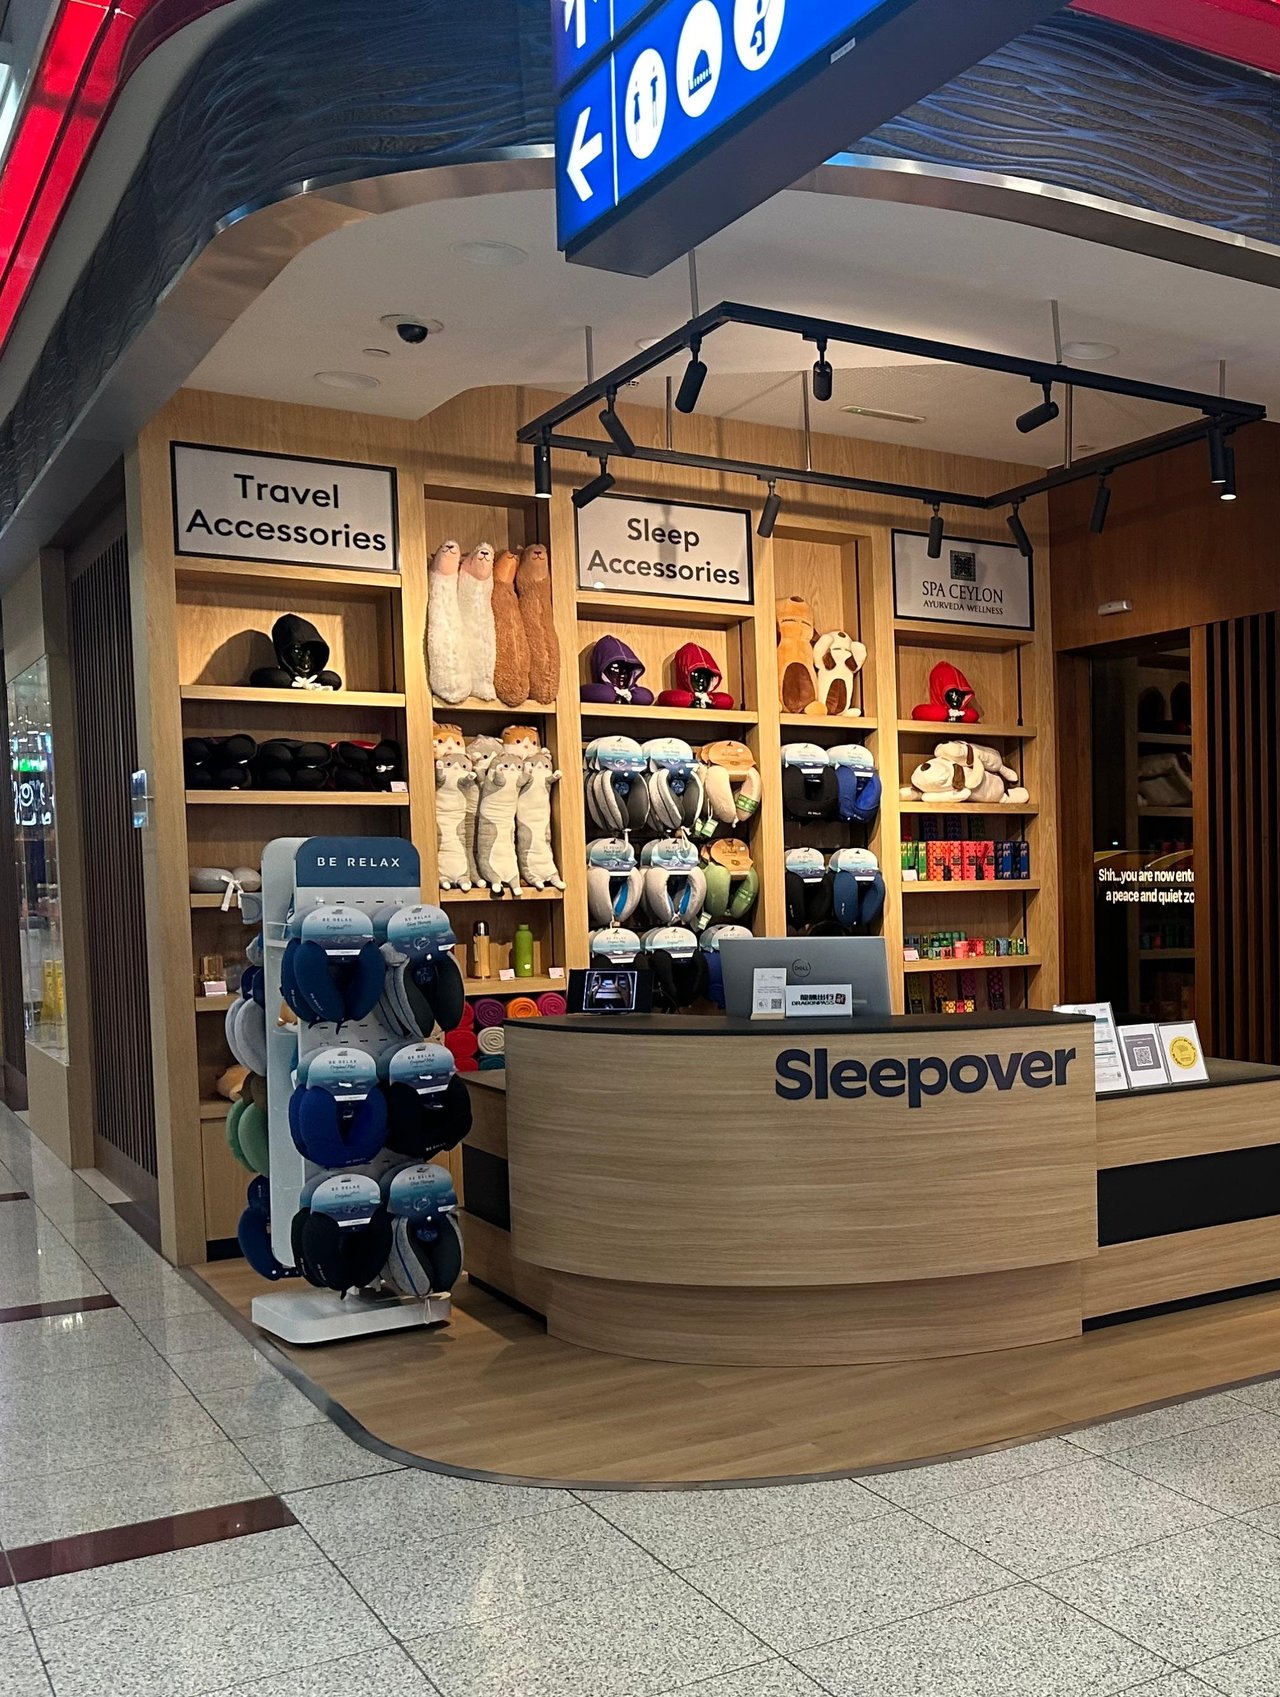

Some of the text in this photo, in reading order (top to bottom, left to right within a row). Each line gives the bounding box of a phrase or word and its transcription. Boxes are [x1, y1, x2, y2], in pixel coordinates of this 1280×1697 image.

[233, 473, 339, 509] Travel
[185, 508, 387, 551] Accessories
[627, 517, 700, 552] Sleep
[587, 549, 740, 585] Accessories
[922, 580, 1003, 604] SPA CEYLON
[923, 600, 1004, 615] AYURVEDA WELLNESS
[317, 857, 400, 867] BE RELAX
[1138, 871, 1153, 882] are
[1154, 871, 1175, 882] now
[1105, 890, 1112, 901] a
[1112, 890, 1139, 904] peace
[1140, 888, 1158, 903] and
[1158, 889, 1183, 905] quiet
[775, 1047, 1077, 1109] Sleepover
